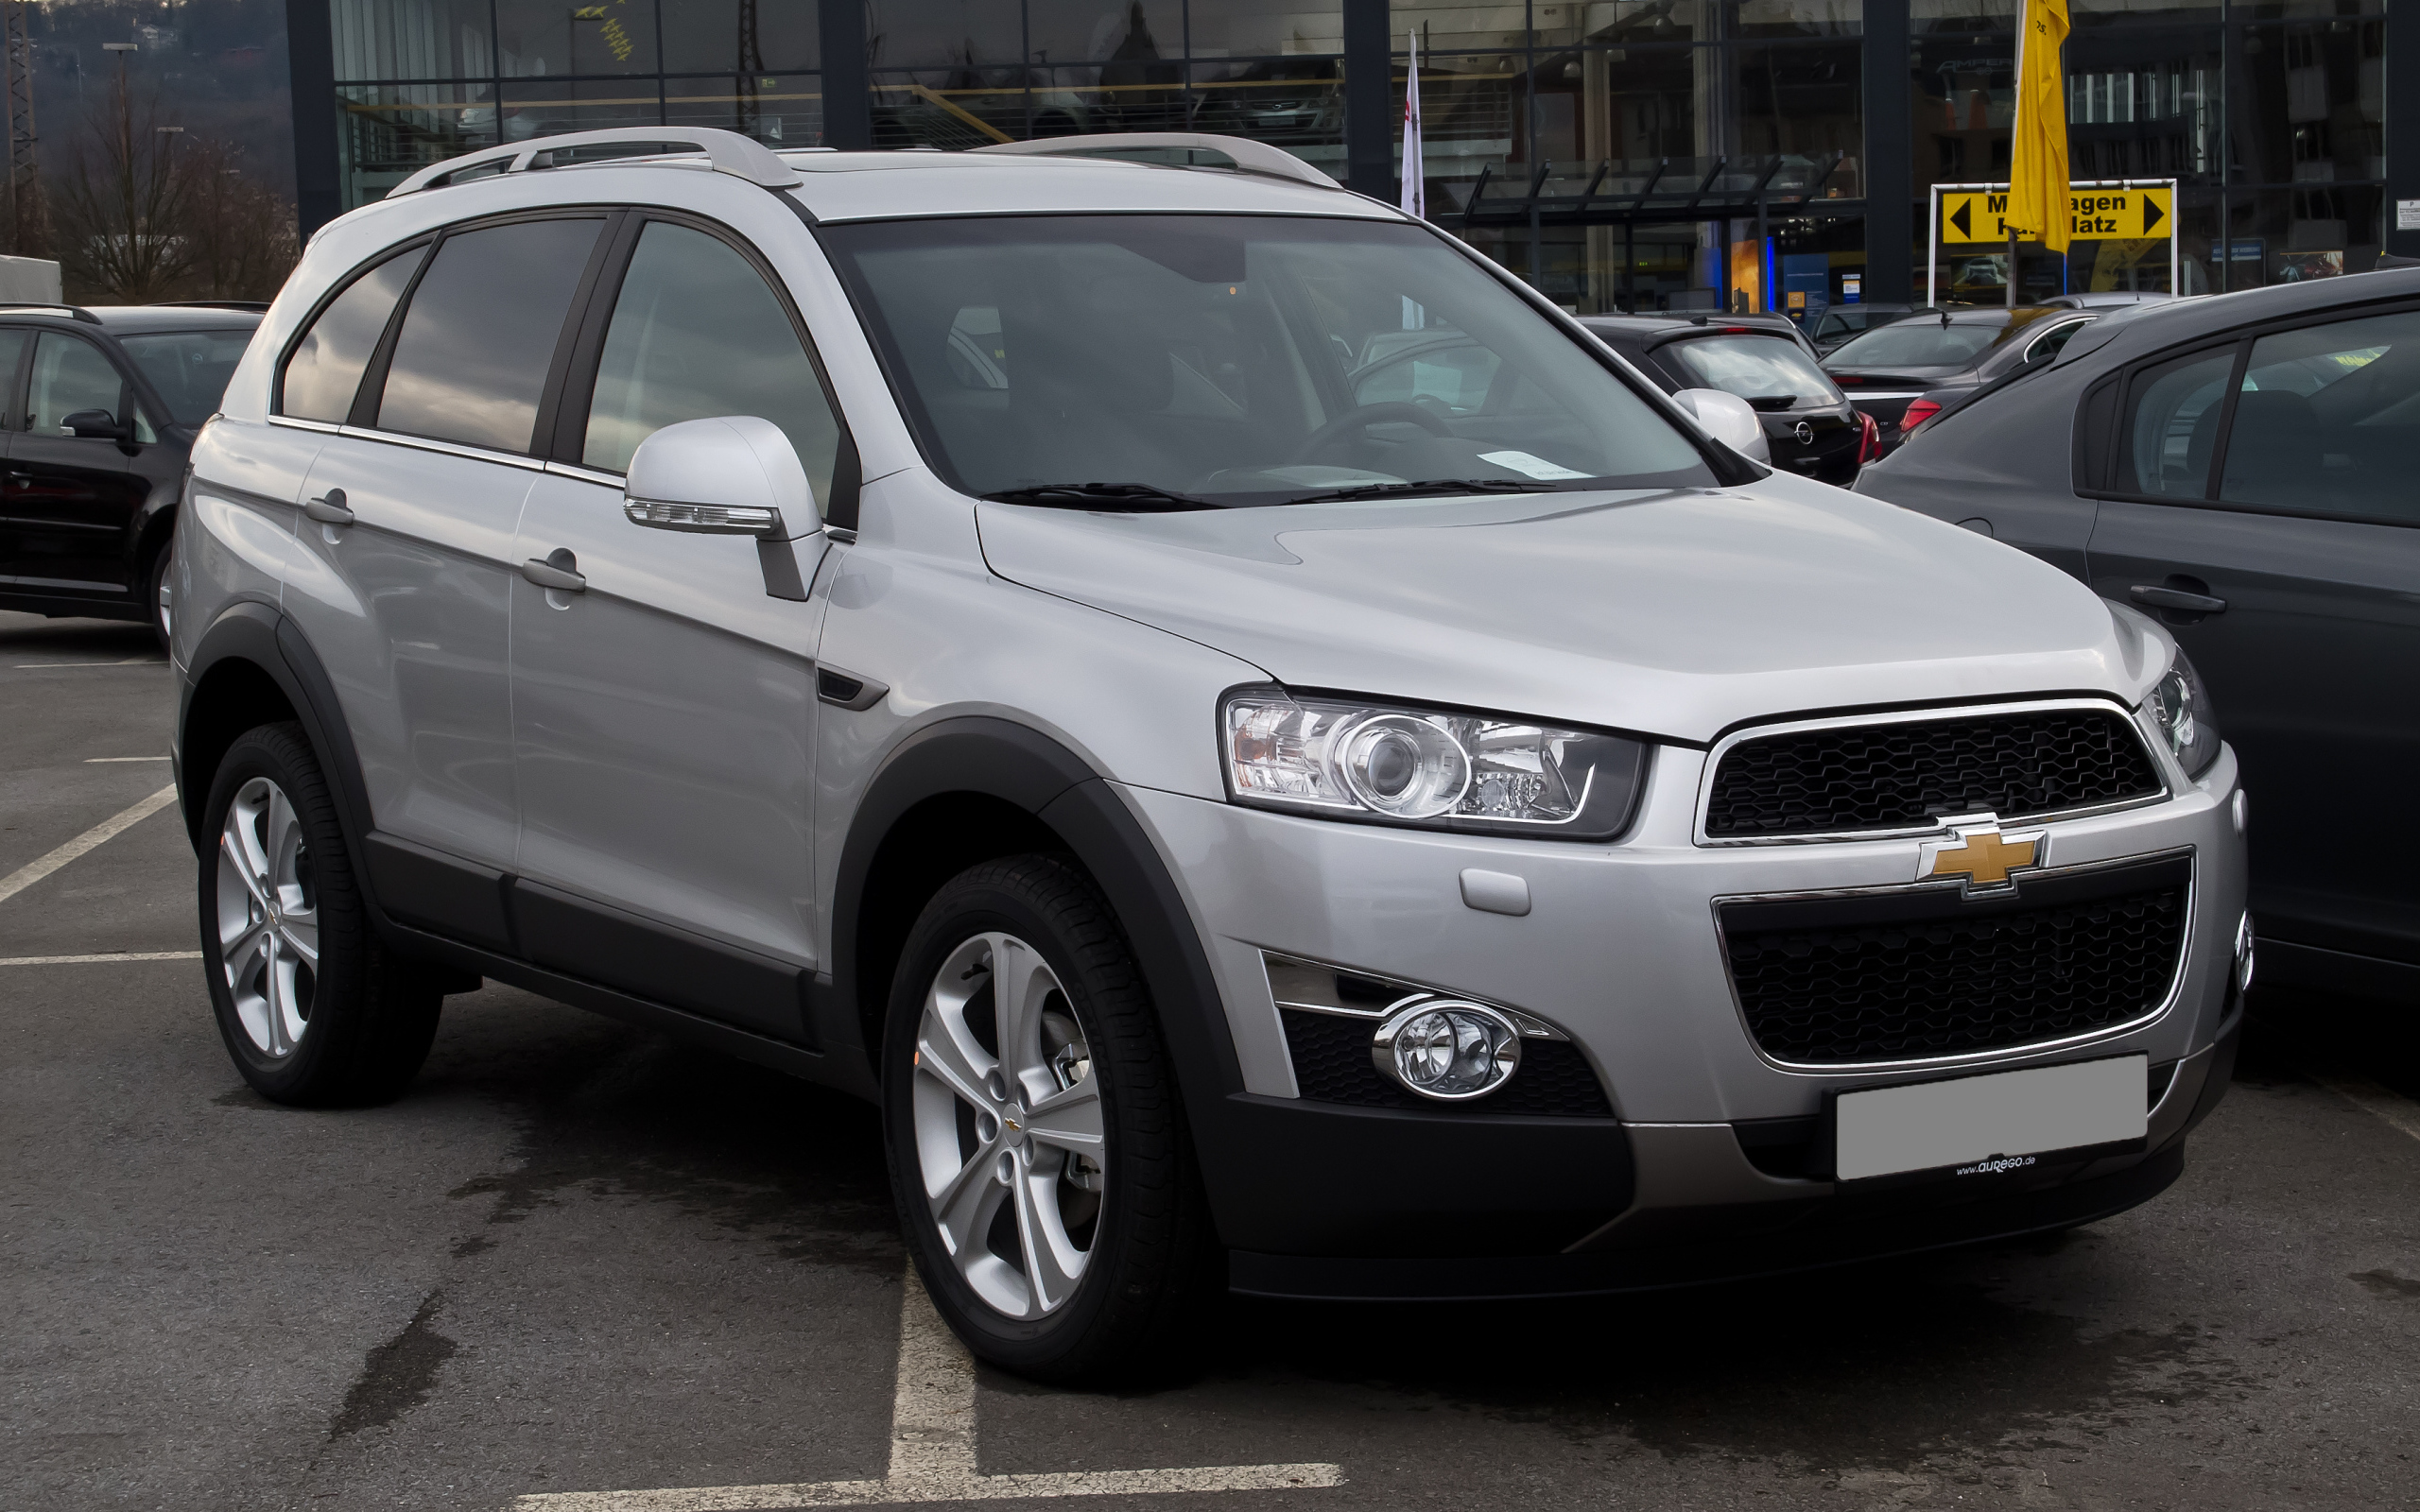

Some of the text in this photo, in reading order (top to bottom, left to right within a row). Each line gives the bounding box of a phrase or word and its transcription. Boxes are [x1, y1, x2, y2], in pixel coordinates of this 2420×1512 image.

[1936, 58, 2014, 74] AMPER
[1987, 195, 2126, 215] Magen
[1997, 215, 2117, 235] Platz
